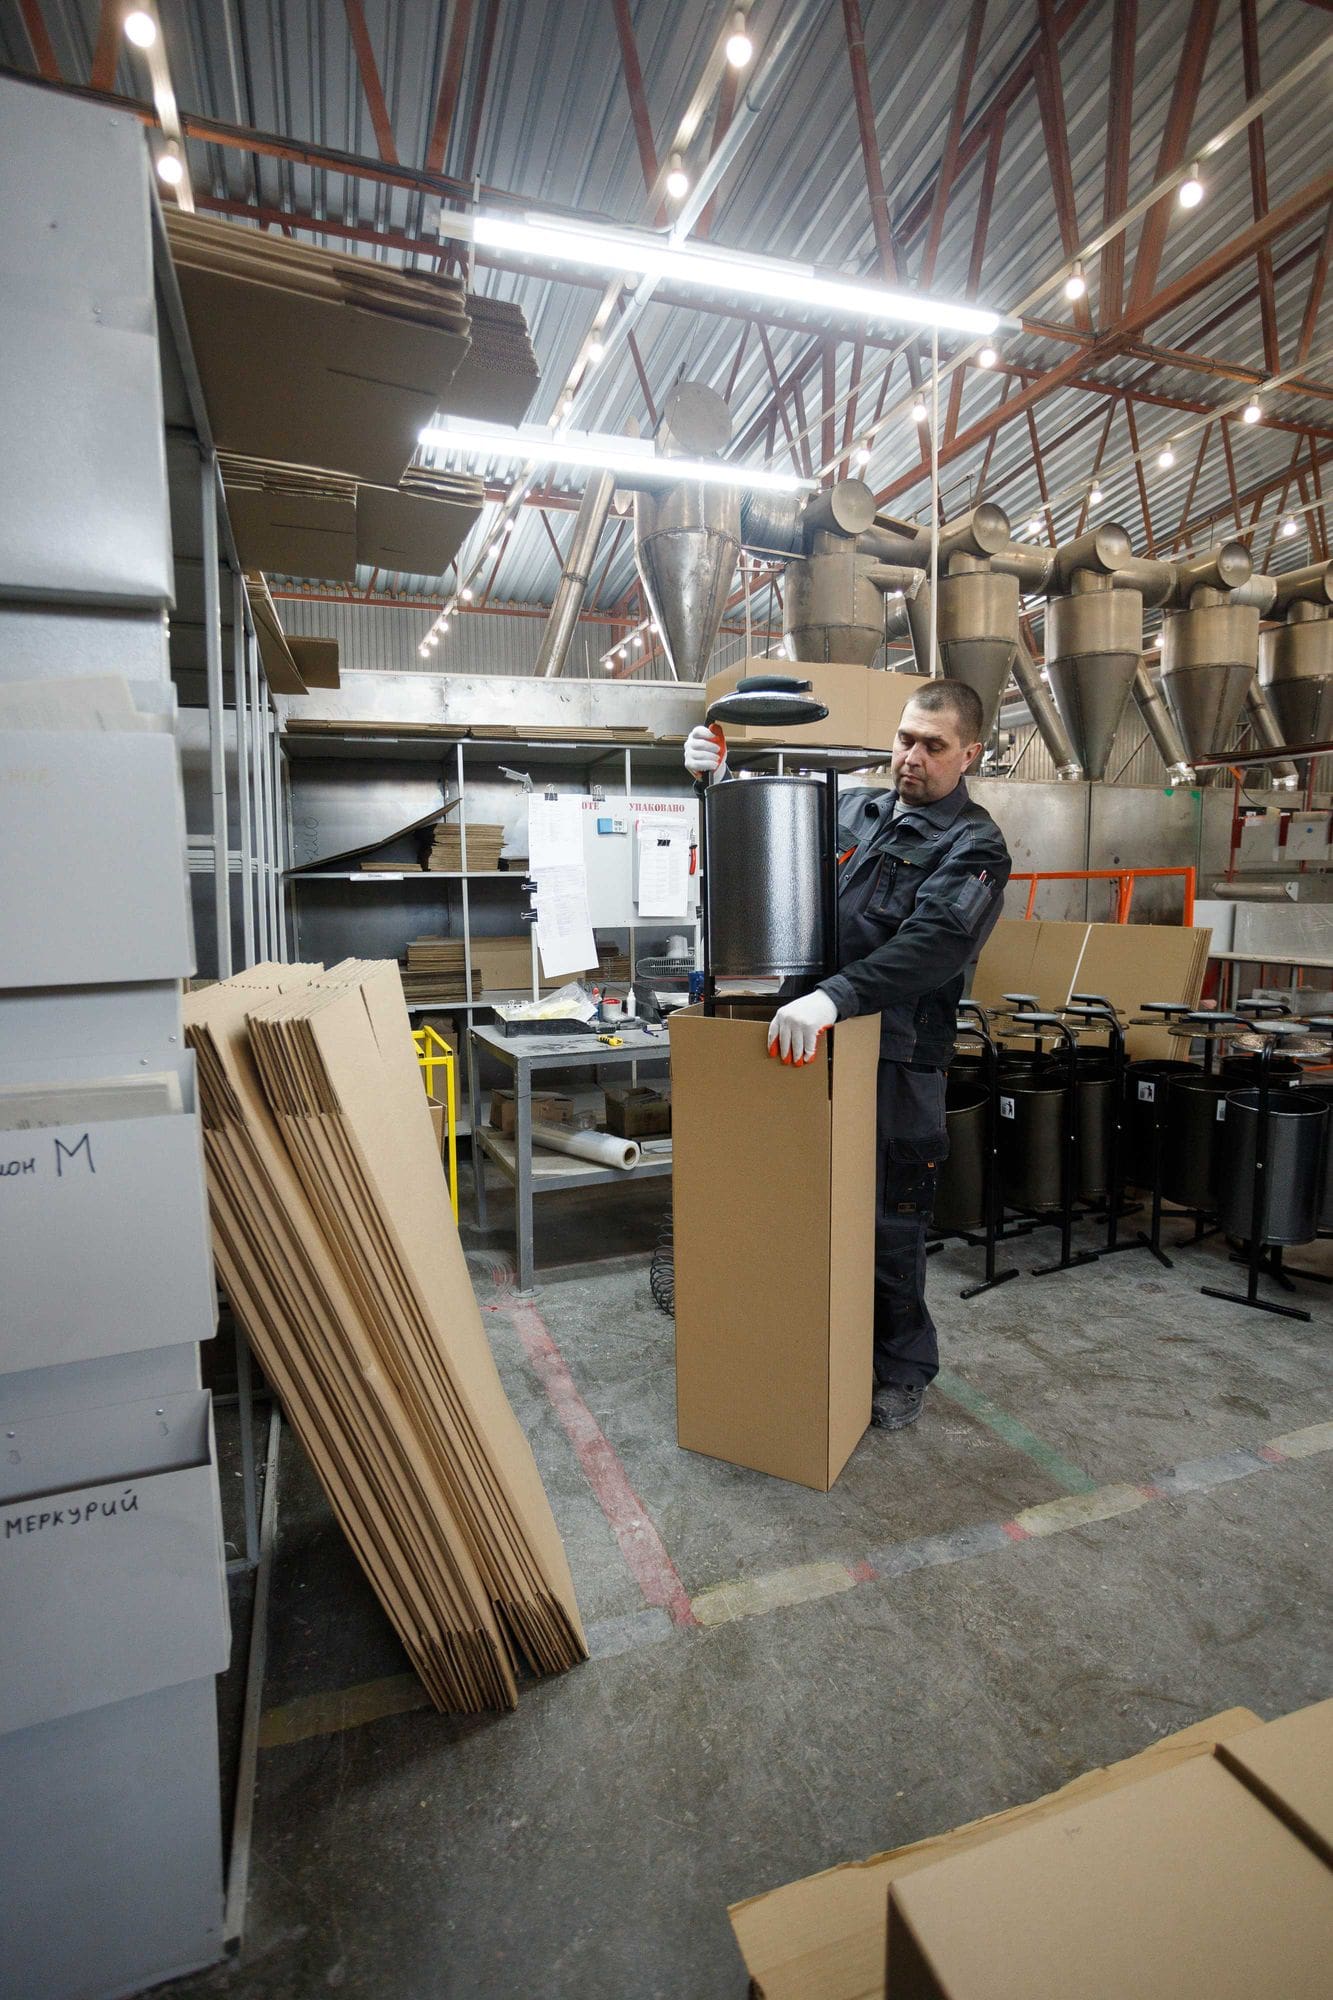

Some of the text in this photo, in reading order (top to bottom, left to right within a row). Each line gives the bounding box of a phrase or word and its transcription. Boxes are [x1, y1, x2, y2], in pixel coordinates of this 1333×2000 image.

[629, 803, 685, 812] УПАКОВАНО
[54, 1133, 96, 1177] М
[5, 1489, 139, 1539] МЕРКУРИЙ
